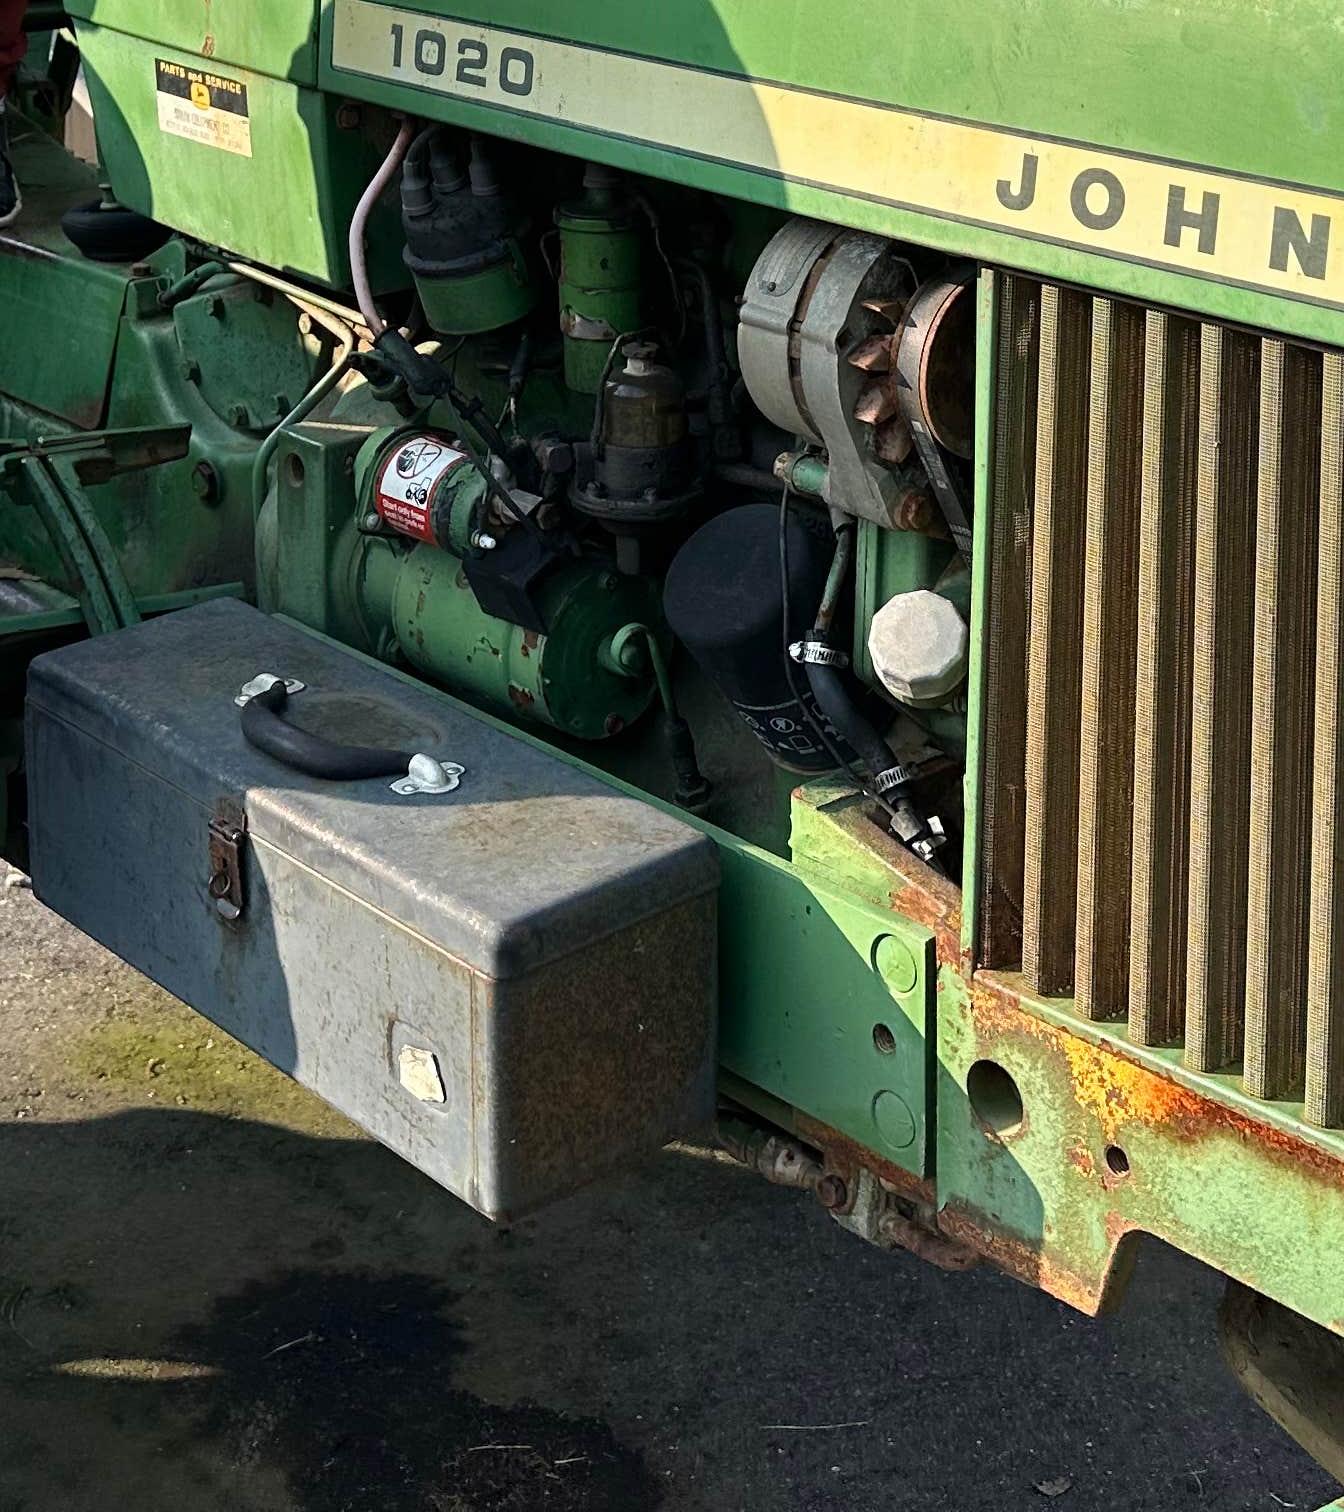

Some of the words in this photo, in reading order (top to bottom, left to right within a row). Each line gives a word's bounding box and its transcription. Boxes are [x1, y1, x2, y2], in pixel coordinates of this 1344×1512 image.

[159, 61, 186, 79] PARTS
[187, 72, 203, 84] and
[205, 74, 242, 94] SERVICE
[391, 23, 534, 97] 1020
[996, 153, 1331, 280] JOHN
